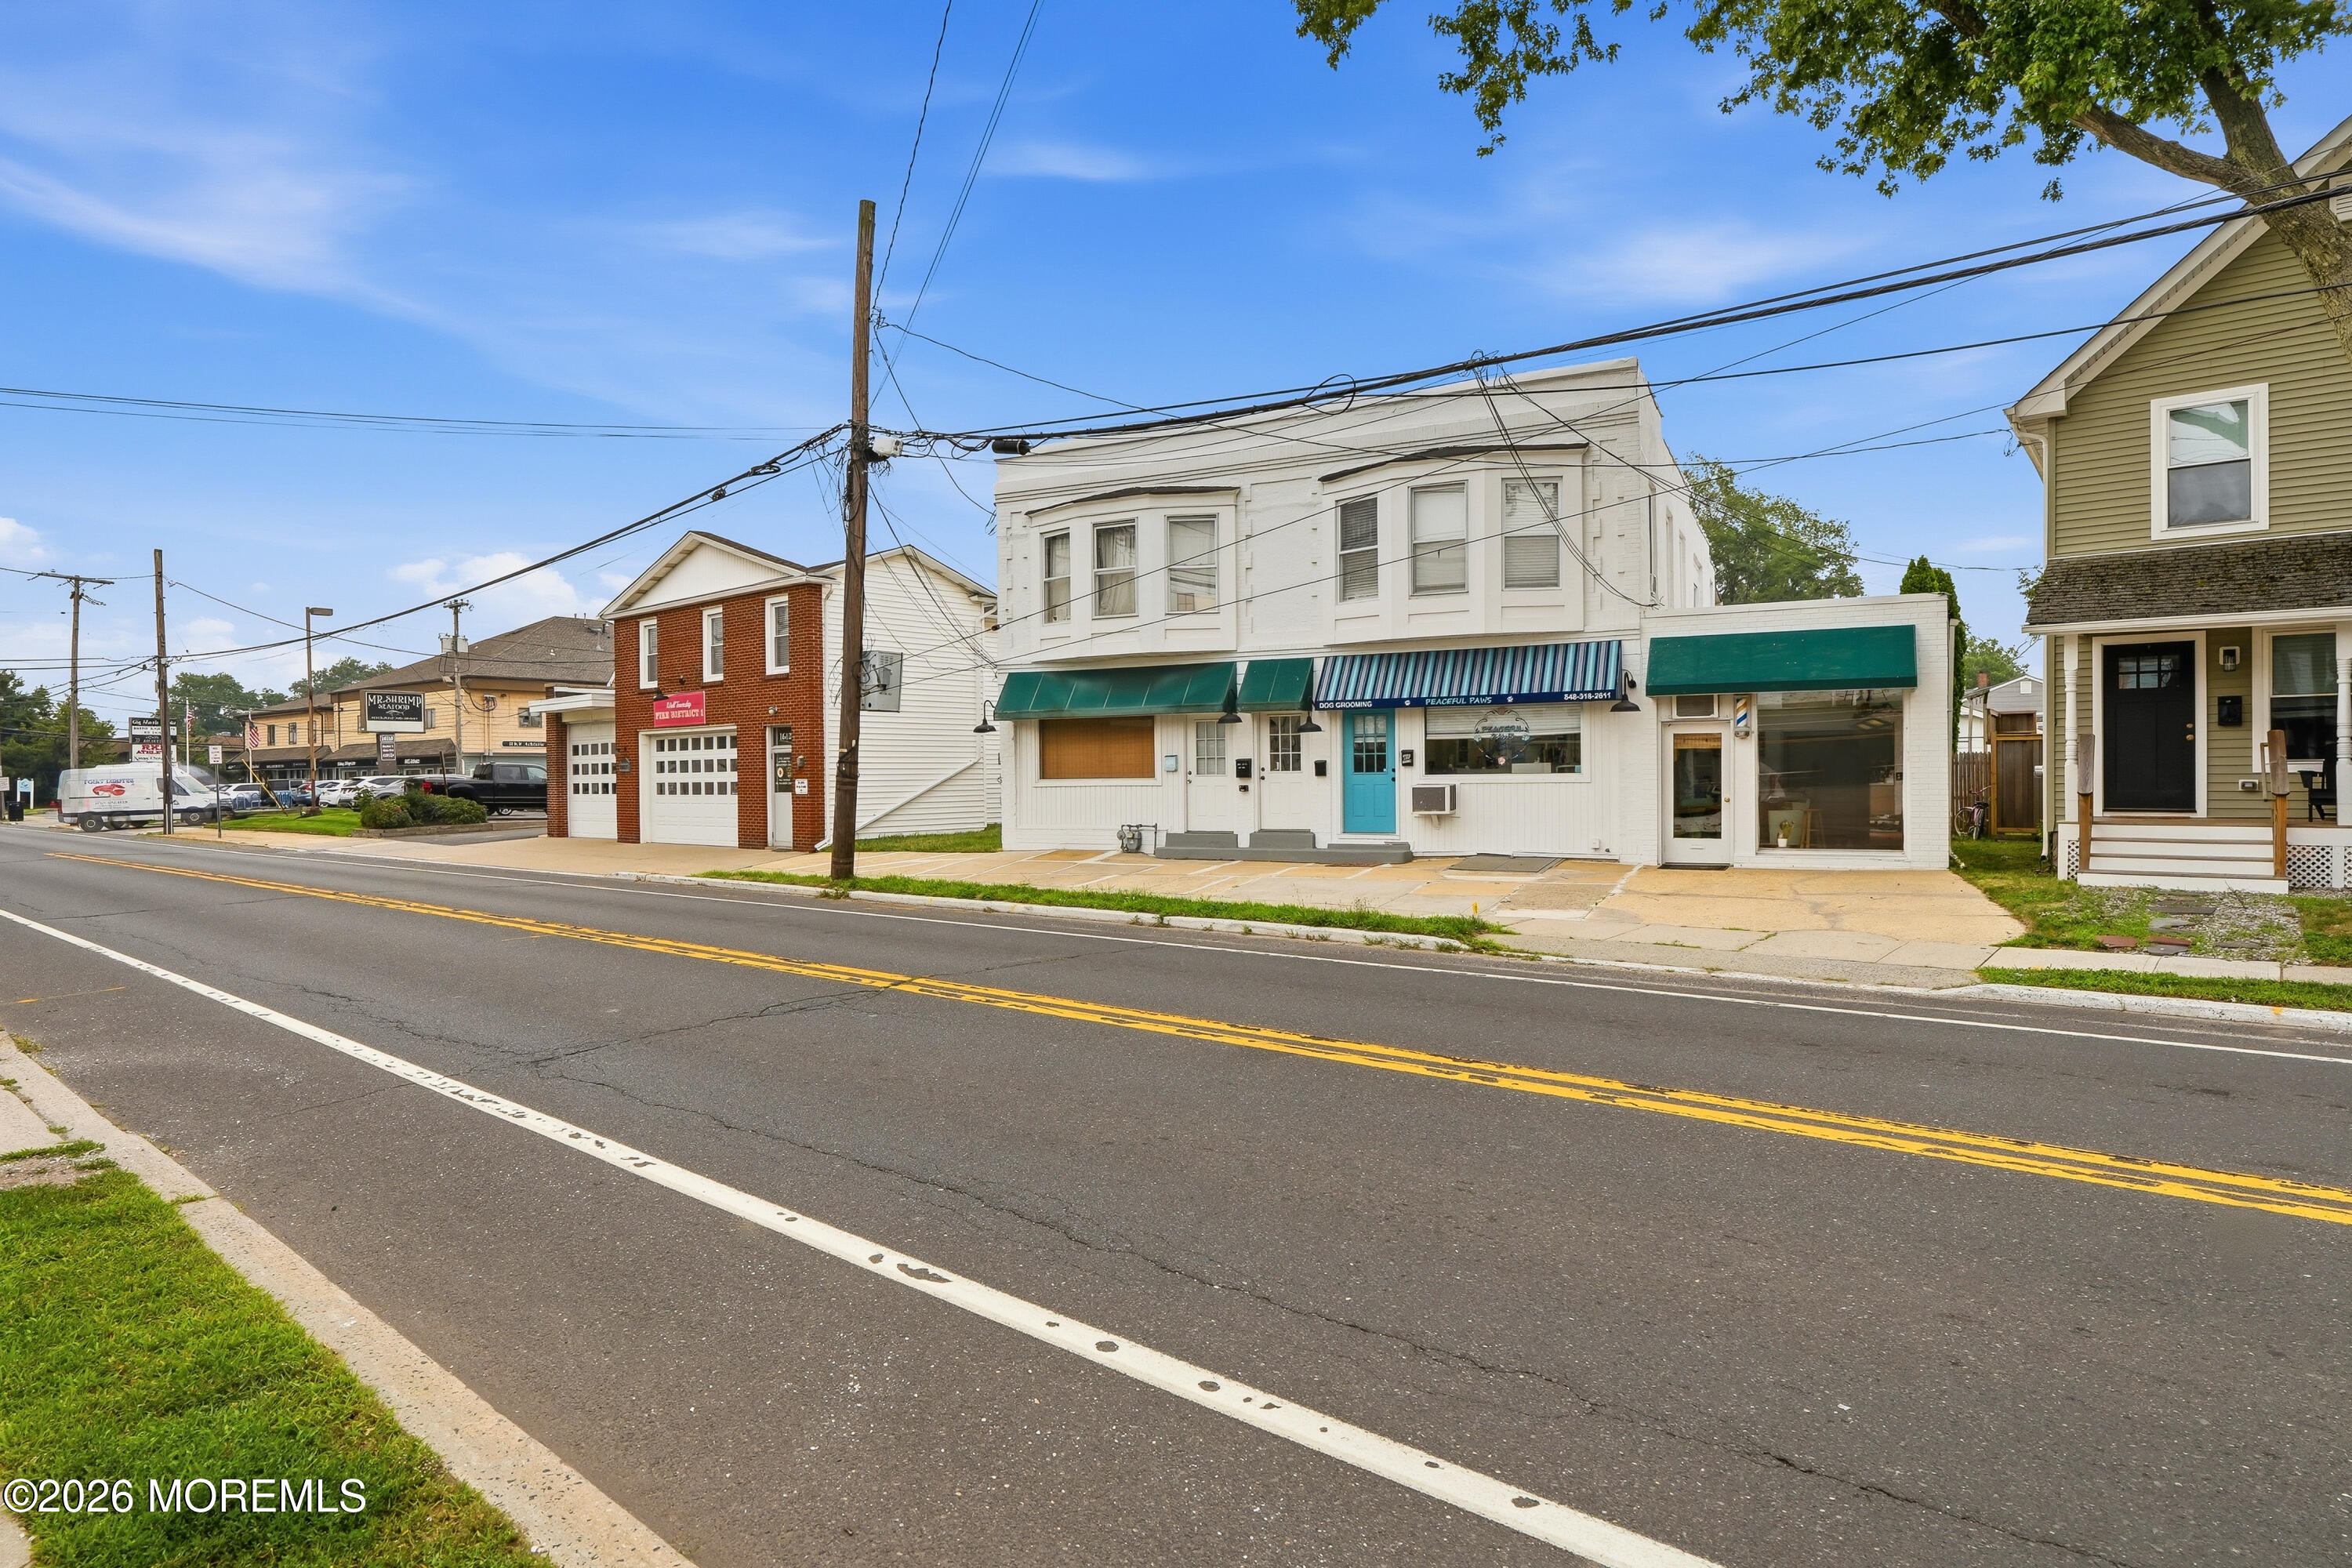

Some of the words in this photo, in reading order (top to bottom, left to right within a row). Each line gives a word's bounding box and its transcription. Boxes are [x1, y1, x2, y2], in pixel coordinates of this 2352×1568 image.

[1425, 697, 1467, 706] PEACEFUL
[655, 711, 670, 720] FIRE
[670, 709, 700, 719] DISTRICT
[700, 708, 704, 717] 1
